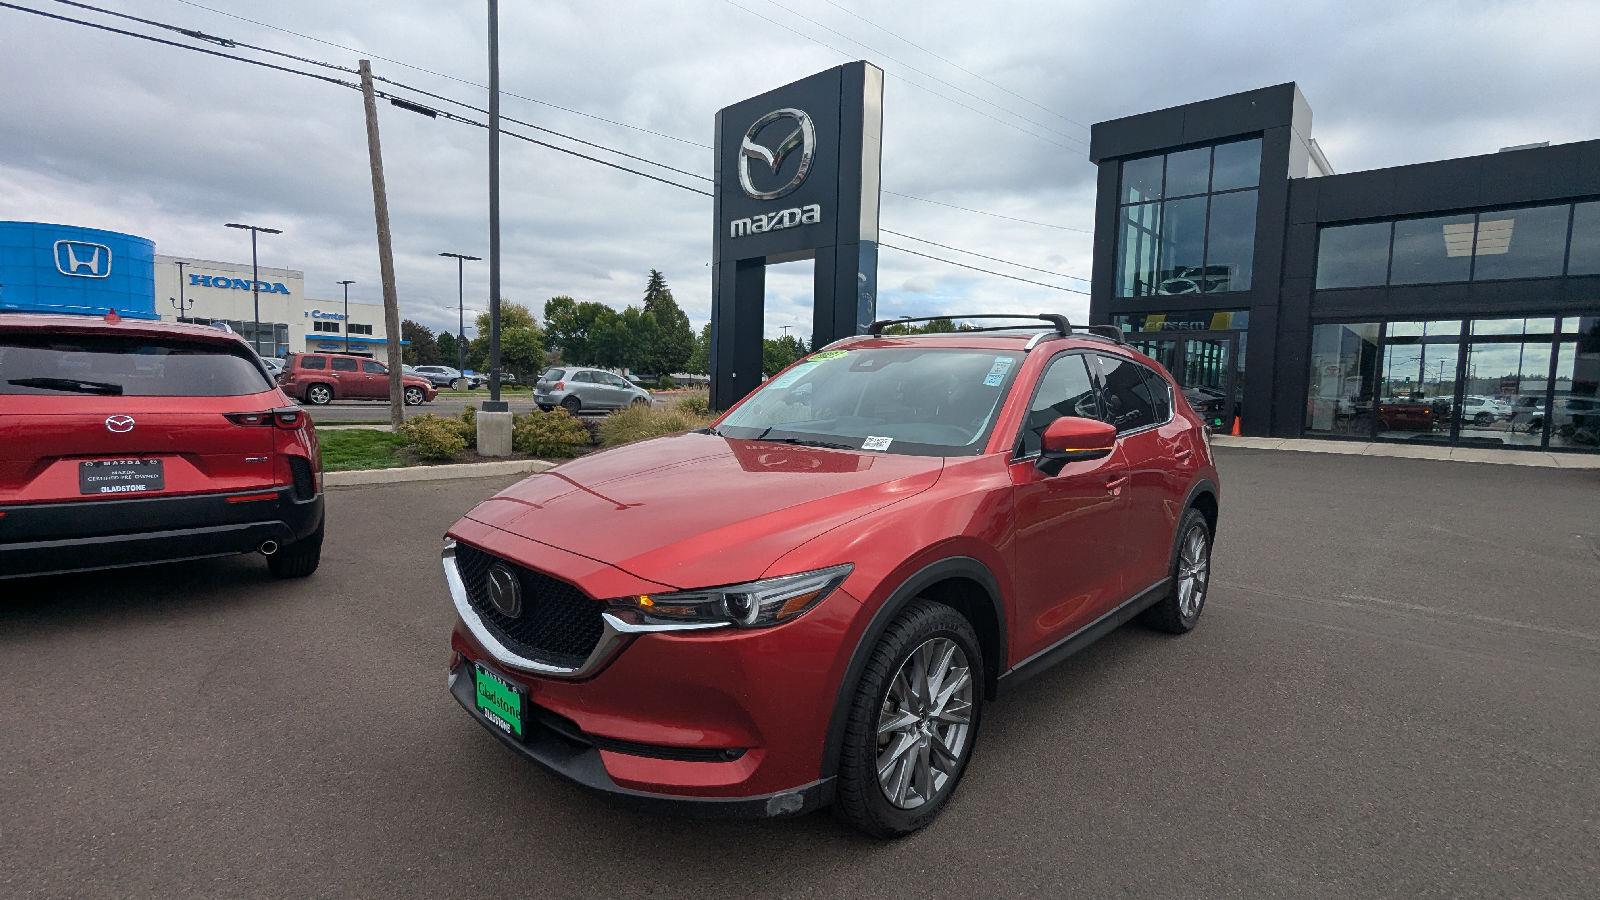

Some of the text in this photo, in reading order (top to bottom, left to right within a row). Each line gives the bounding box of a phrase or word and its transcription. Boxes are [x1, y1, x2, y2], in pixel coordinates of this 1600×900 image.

[730, 203, 821, 237] mazda
[189, 273, 291, 295] HONDA
[100, 484, 147, 493] GLADSTONE
[478, 681, 521, 720] Gladstone
